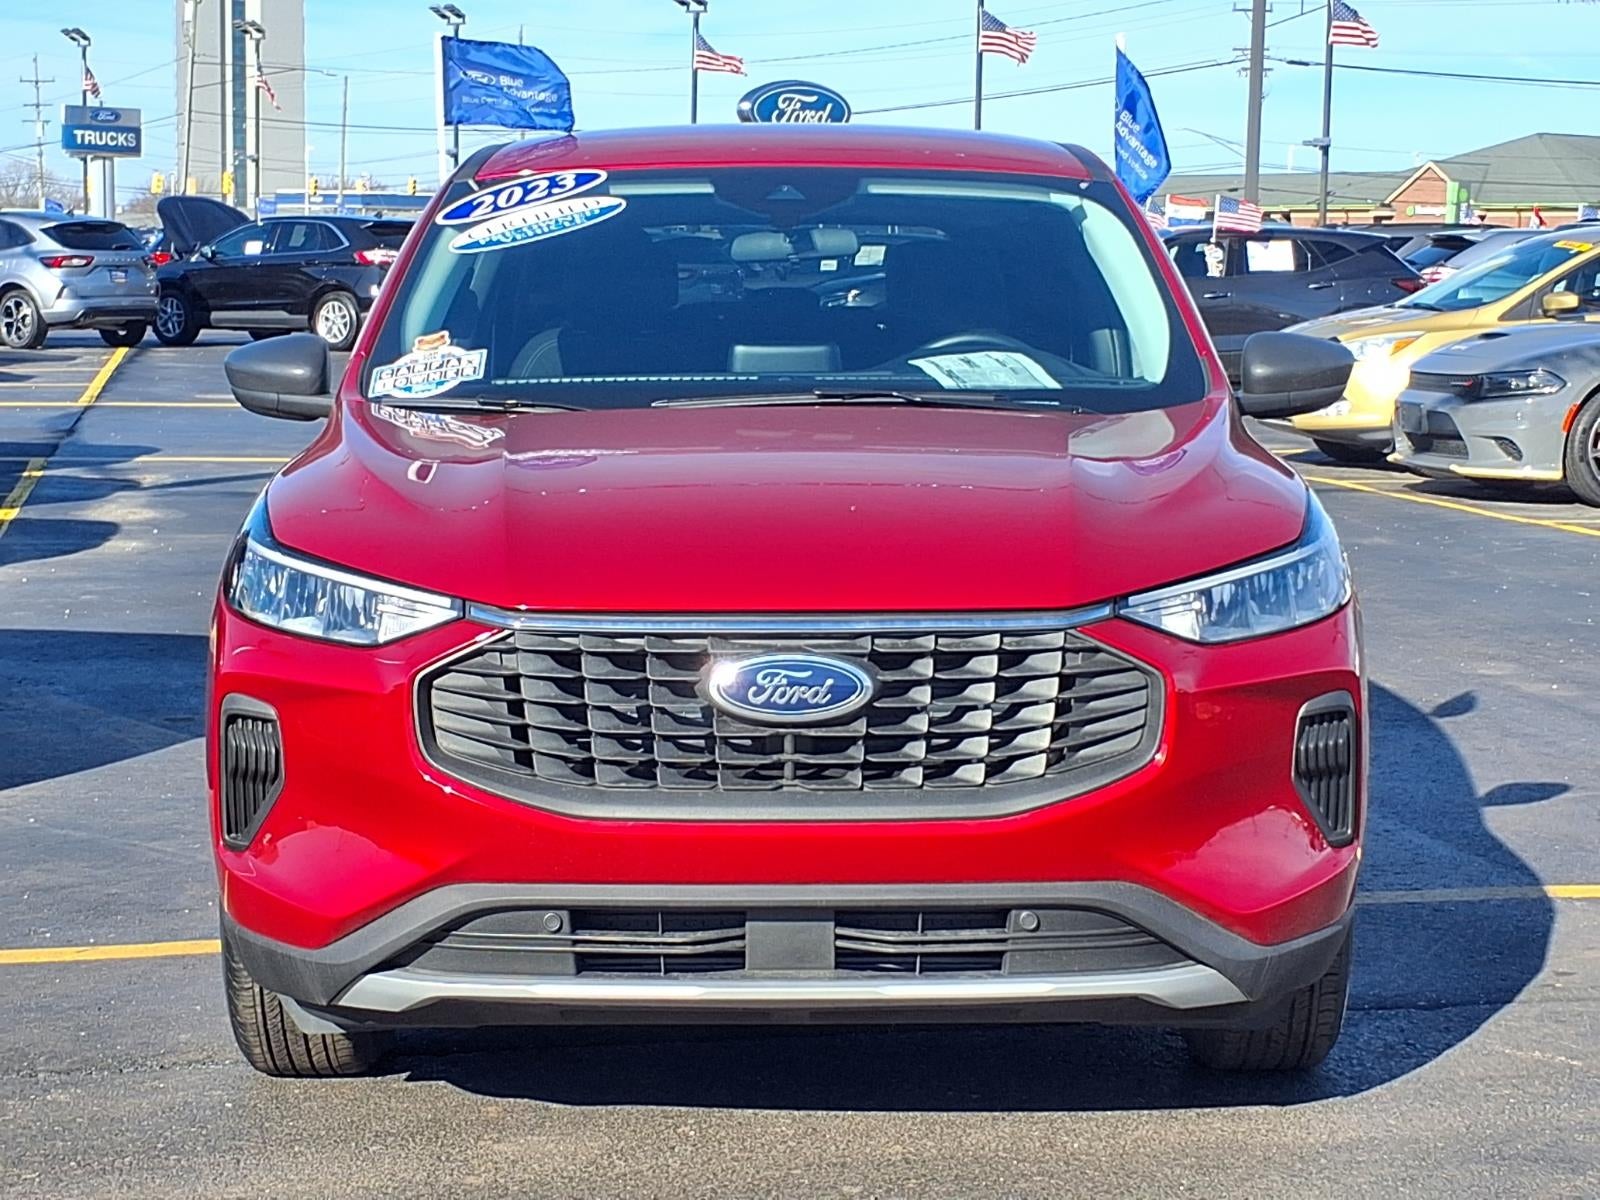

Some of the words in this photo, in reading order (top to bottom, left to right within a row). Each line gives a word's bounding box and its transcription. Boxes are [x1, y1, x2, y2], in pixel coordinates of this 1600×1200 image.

[500, 75, 524, 88] Blue
[1120, 110, 1141, 133] Blue
[73, 129, 137, 147] TRUCKS
[1116, 121, 1158, 169] Advantage
[469, 173, 577, 219] 2023
[747, 668, 835, 706] Ford
